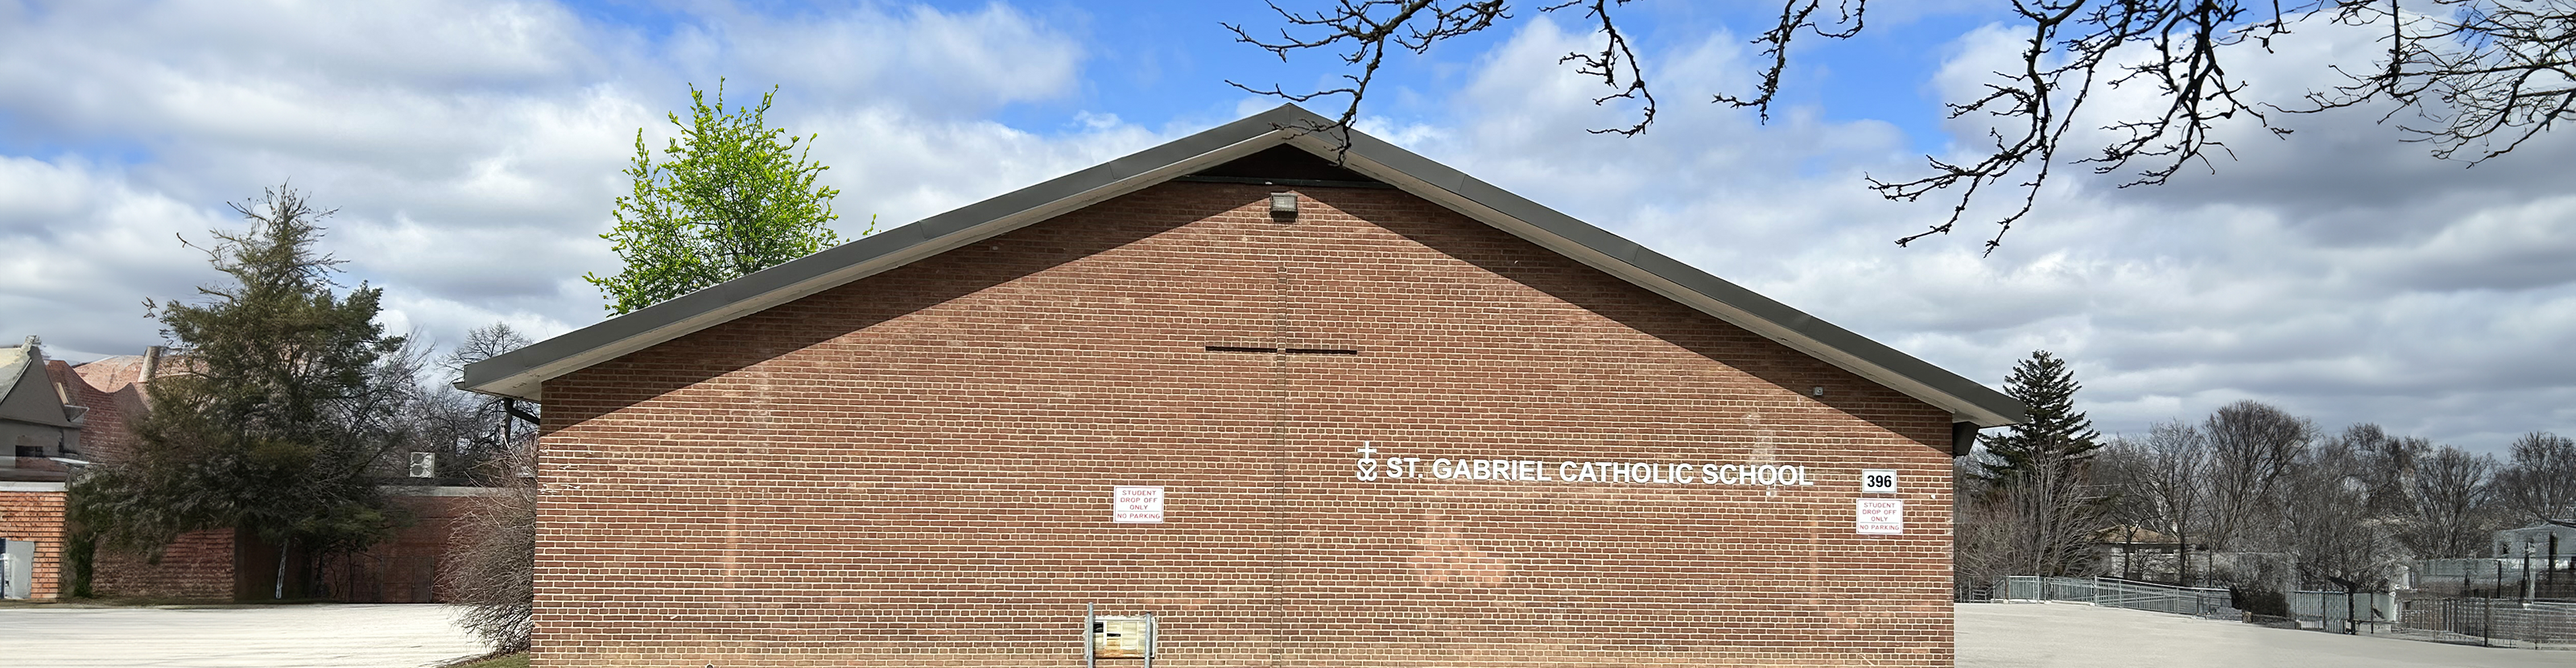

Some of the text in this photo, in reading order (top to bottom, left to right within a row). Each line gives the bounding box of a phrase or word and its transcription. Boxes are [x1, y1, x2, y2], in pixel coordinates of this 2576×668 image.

[1385, 457, 1814, 486] ST. GABRIEL CATHOLIC SCHOOL
[1867, 475, 1892, 488] 396
